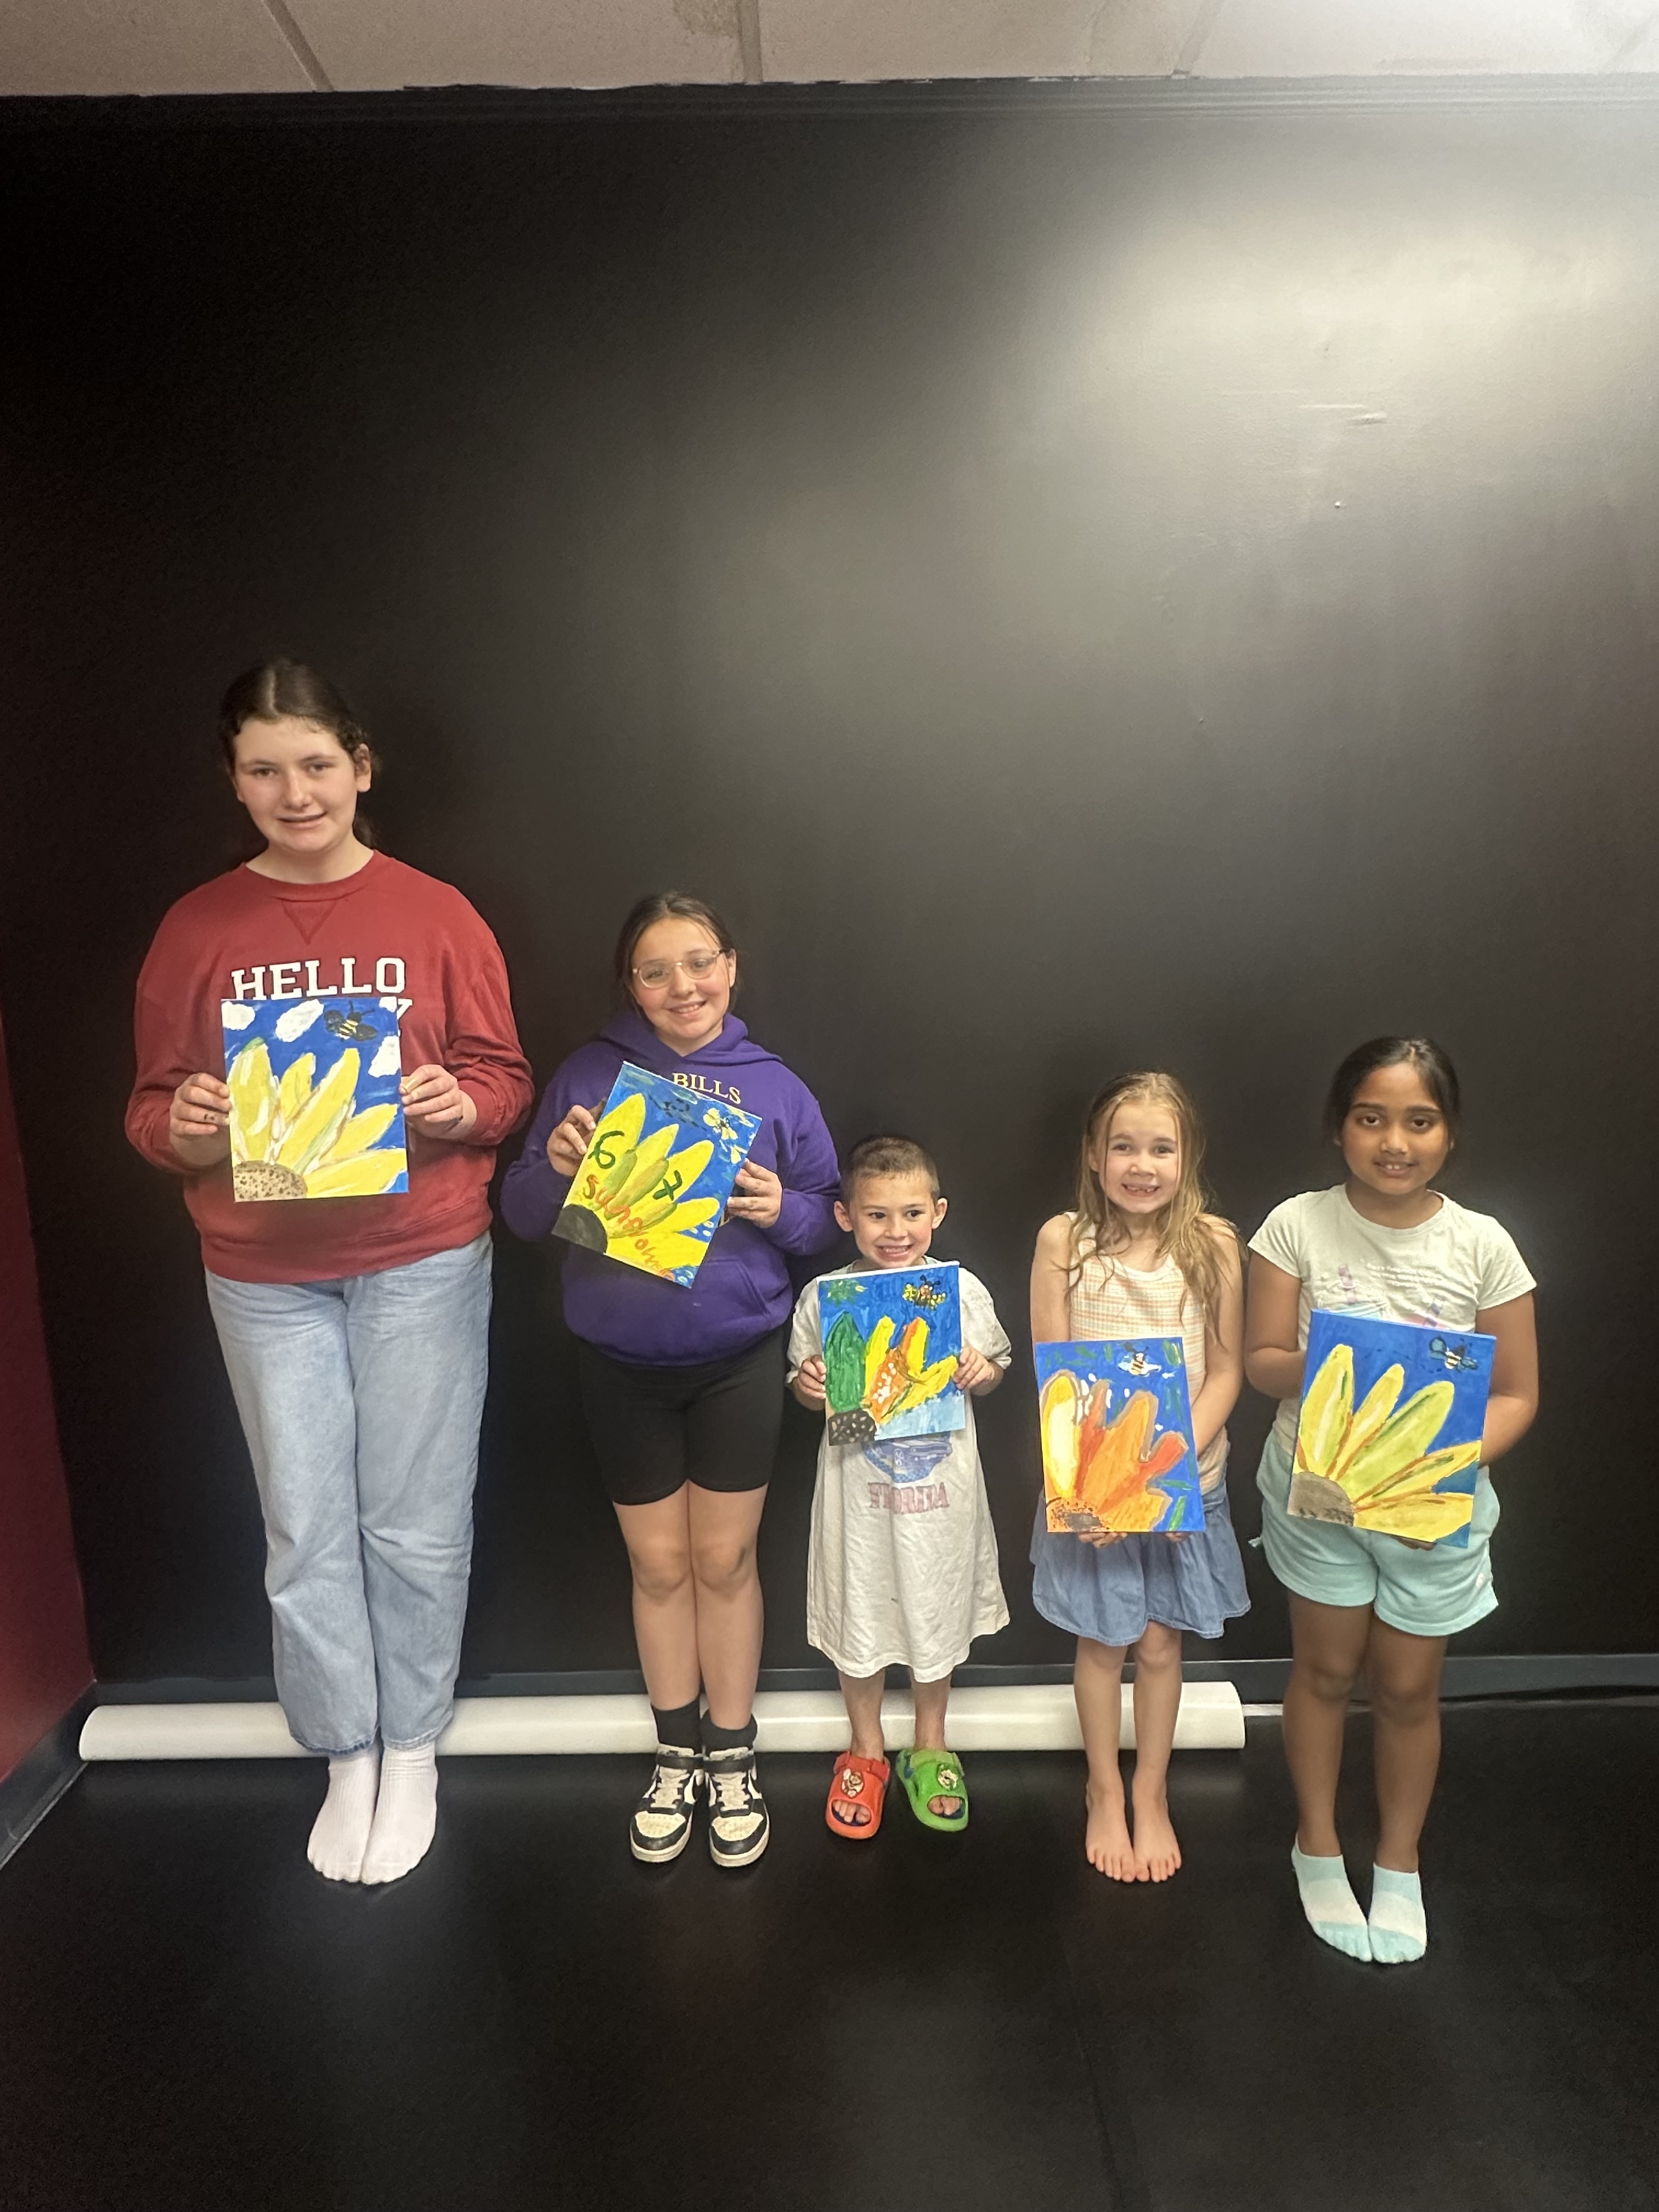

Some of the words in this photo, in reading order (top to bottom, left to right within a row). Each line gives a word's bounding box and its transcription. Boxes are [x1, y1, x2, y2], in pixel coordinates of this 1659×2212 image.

[231, 957, 405, 1000] HELLO
[672, 1072, 741, 1104] BILLS
[588, 1130, 625, 1170] 6
